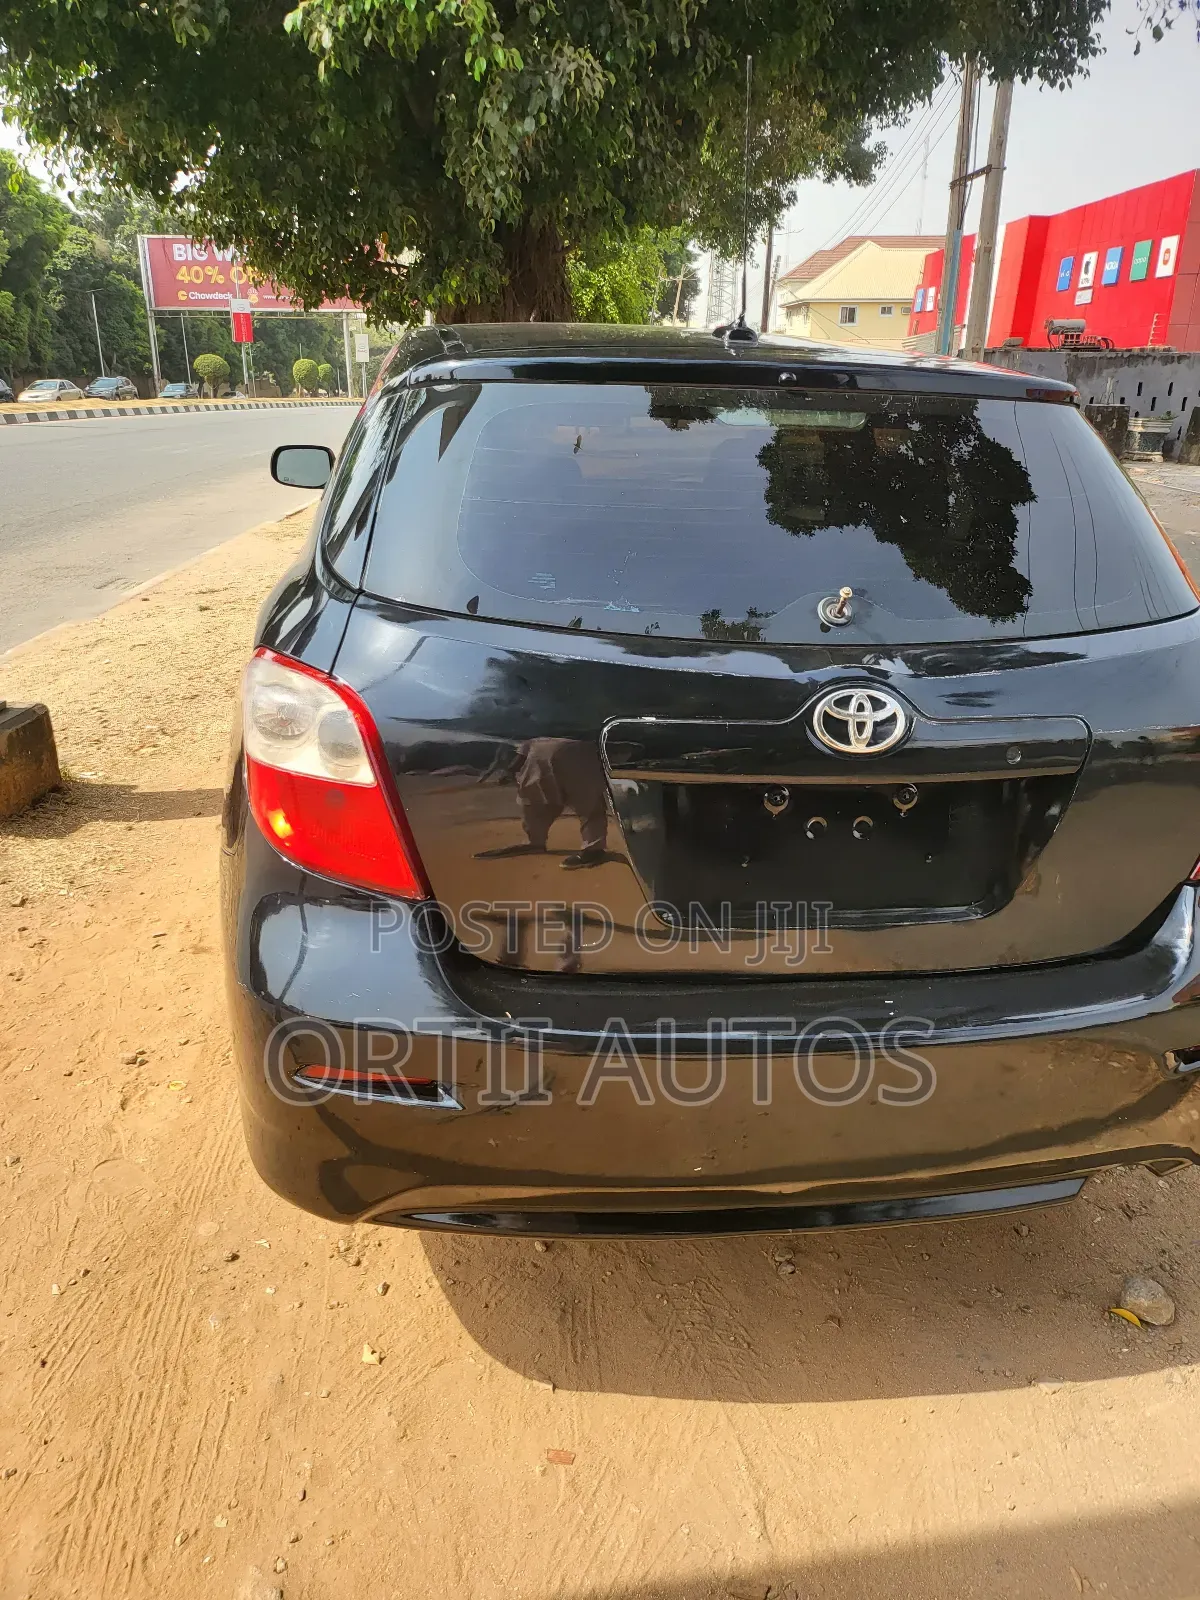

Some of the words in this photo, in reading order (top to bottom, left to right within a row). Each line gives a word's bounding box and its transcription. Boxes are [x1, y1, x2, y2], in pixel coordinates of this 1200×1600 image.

[172, 243, 208, 261] BIG
[176, 265, 225, 284] 40%
[188, 291, 233, 300] Chowdeck
